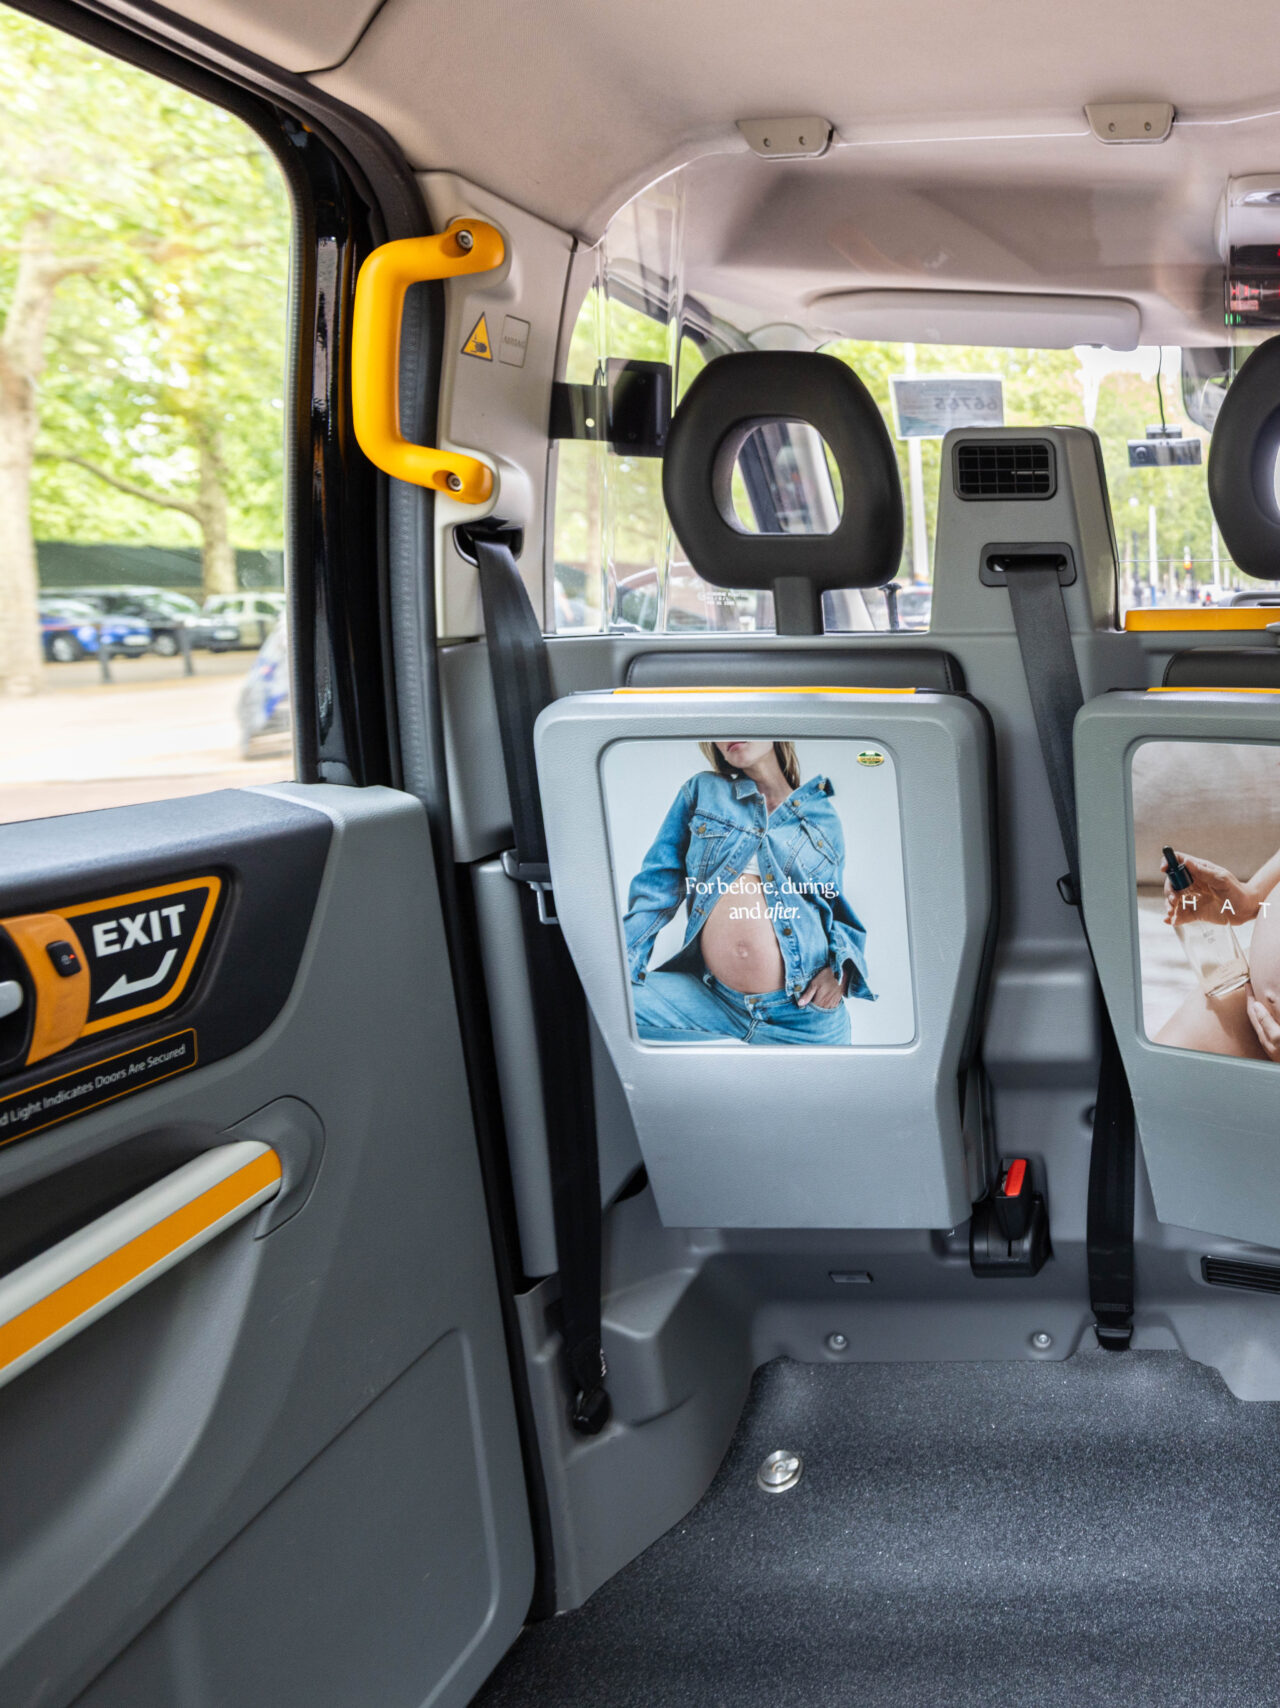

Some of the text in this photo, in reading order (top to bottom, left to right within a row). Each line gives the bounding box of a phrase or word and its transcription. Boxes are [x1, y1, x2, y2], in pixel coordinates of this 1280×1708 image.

[685, 876, 840, 898] For before, during,
[92, 903, 187, 958] EXIT
[729, 903, 801, 921] and after.
[10, 1101, 43, 1121] Light
[43, 1080, 95, 1108] Indicates
[95, 1068, 127, 1089] Doors
[128, 1061, 146, 1075] Are
[147, 1043, 187, 1069] Secured
